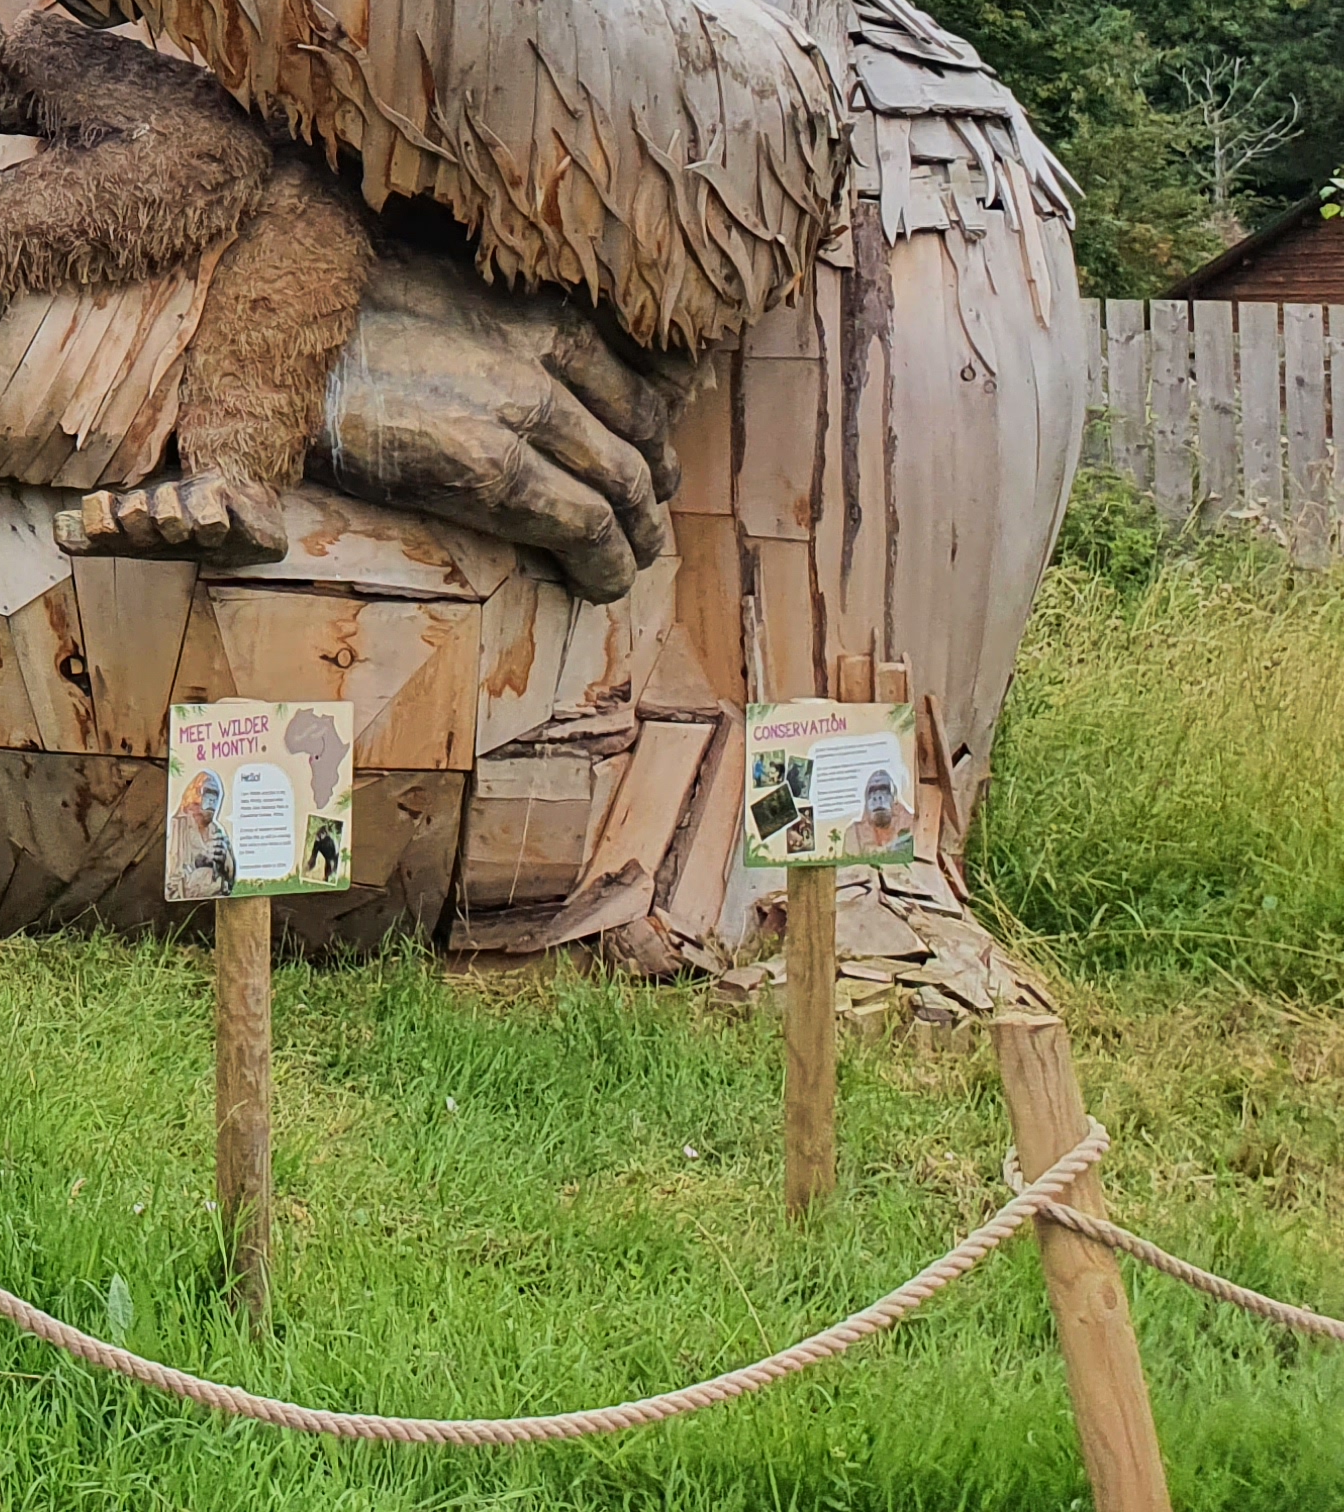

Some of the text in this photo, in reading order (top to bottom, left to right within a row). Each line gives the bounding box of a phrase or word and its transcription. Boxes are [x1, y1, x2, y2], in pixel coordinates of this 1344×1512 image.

[179, 715, 269, 744] MEET WILDER
[753, 717, 847, 742] CONSERVATION
[197, 736, 258, 761] & MONTY!
